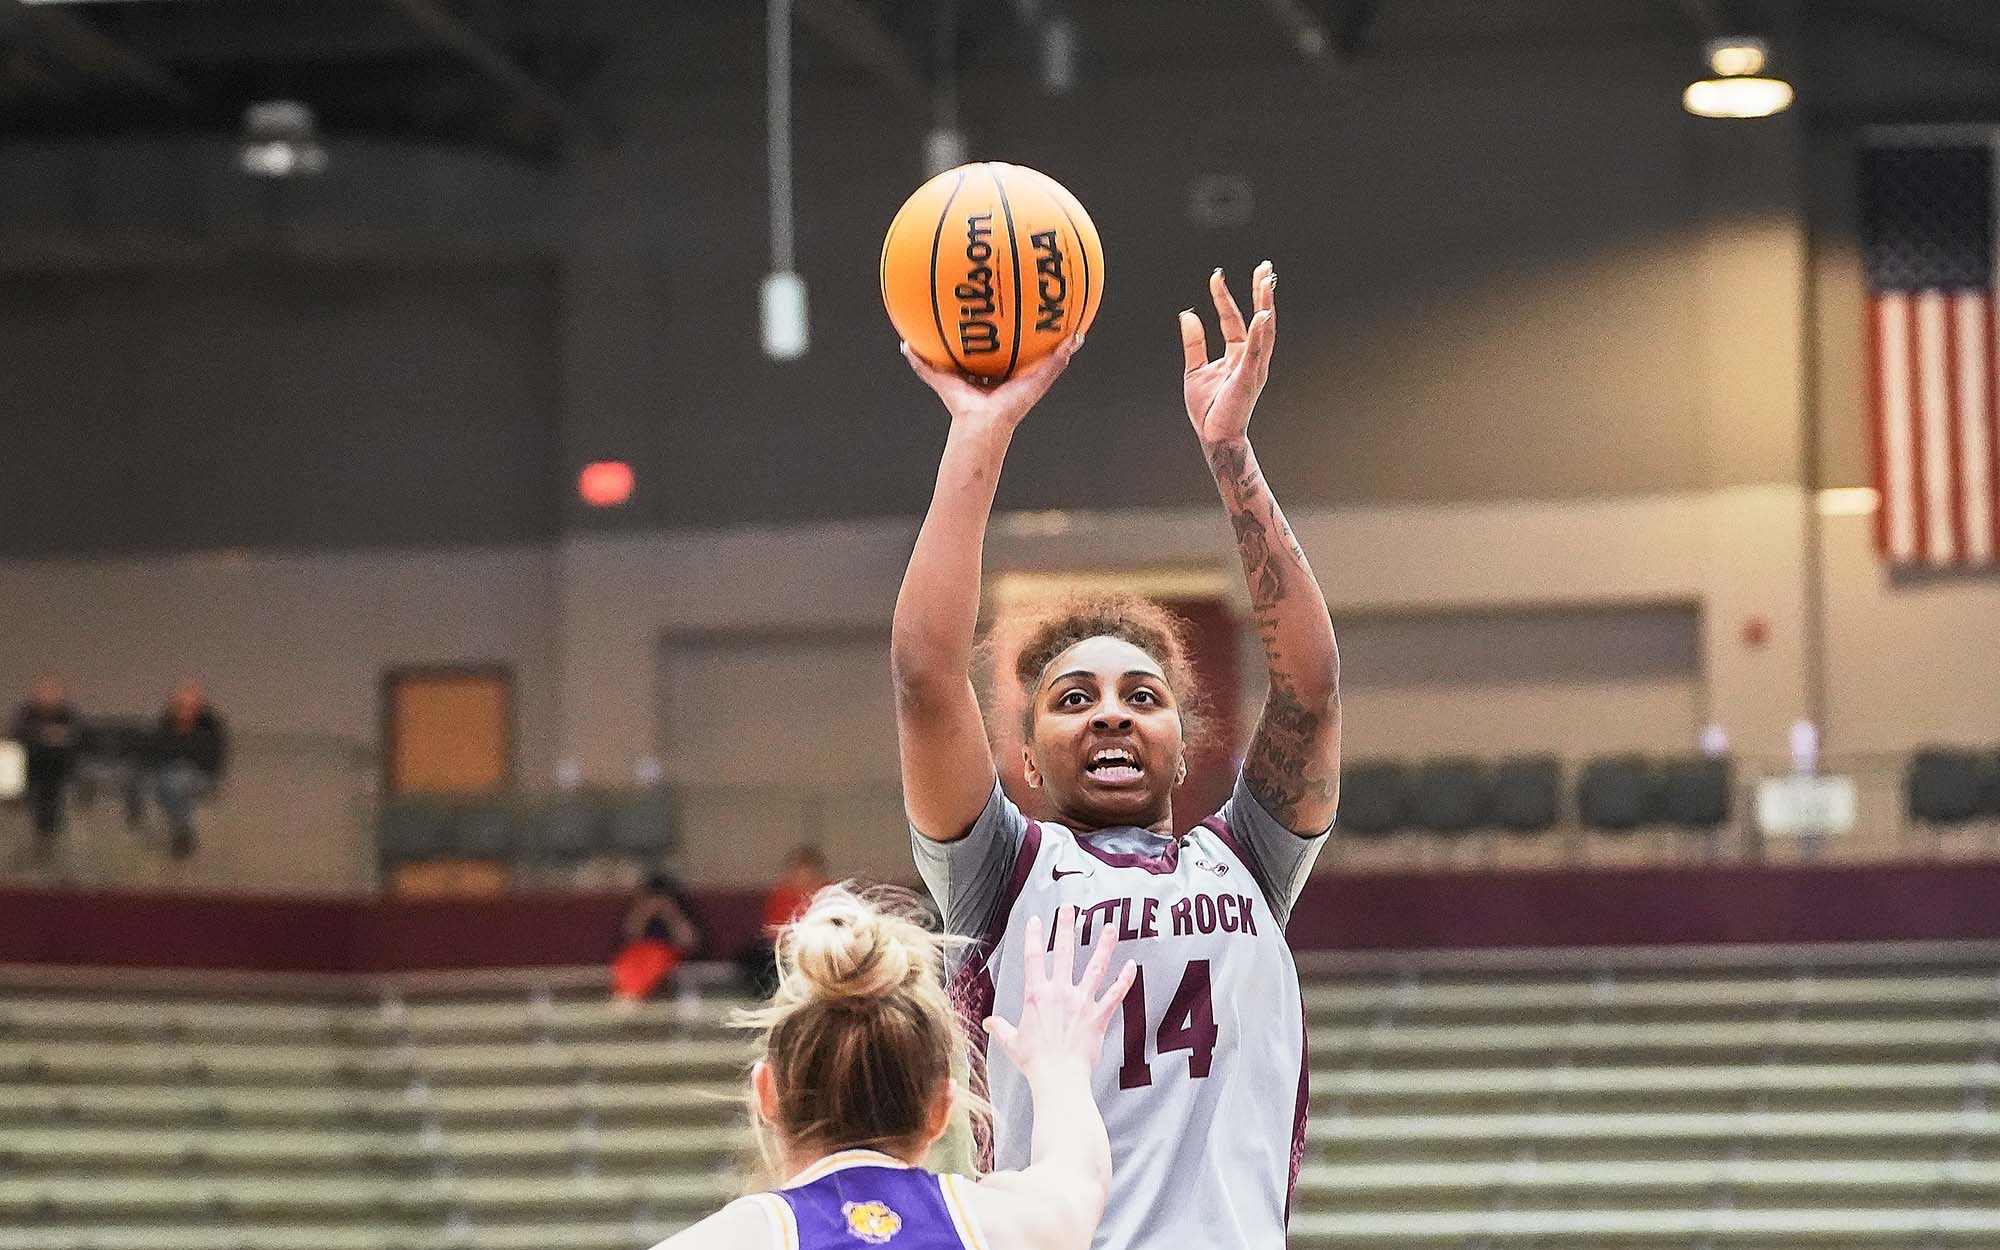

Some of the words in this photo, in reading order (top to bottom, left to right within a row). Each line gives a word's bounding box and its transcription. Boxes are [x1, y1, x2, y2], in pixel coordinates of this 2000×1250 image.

[955, 212, 1000, 356] Wilson
[1031, 229, 1066, 333] NCAA
[1047, 897, 1159, 953] TTLE
[1171, 893, 1258, 937] ROCK
[1119, 959, 1219, 1091] 14
